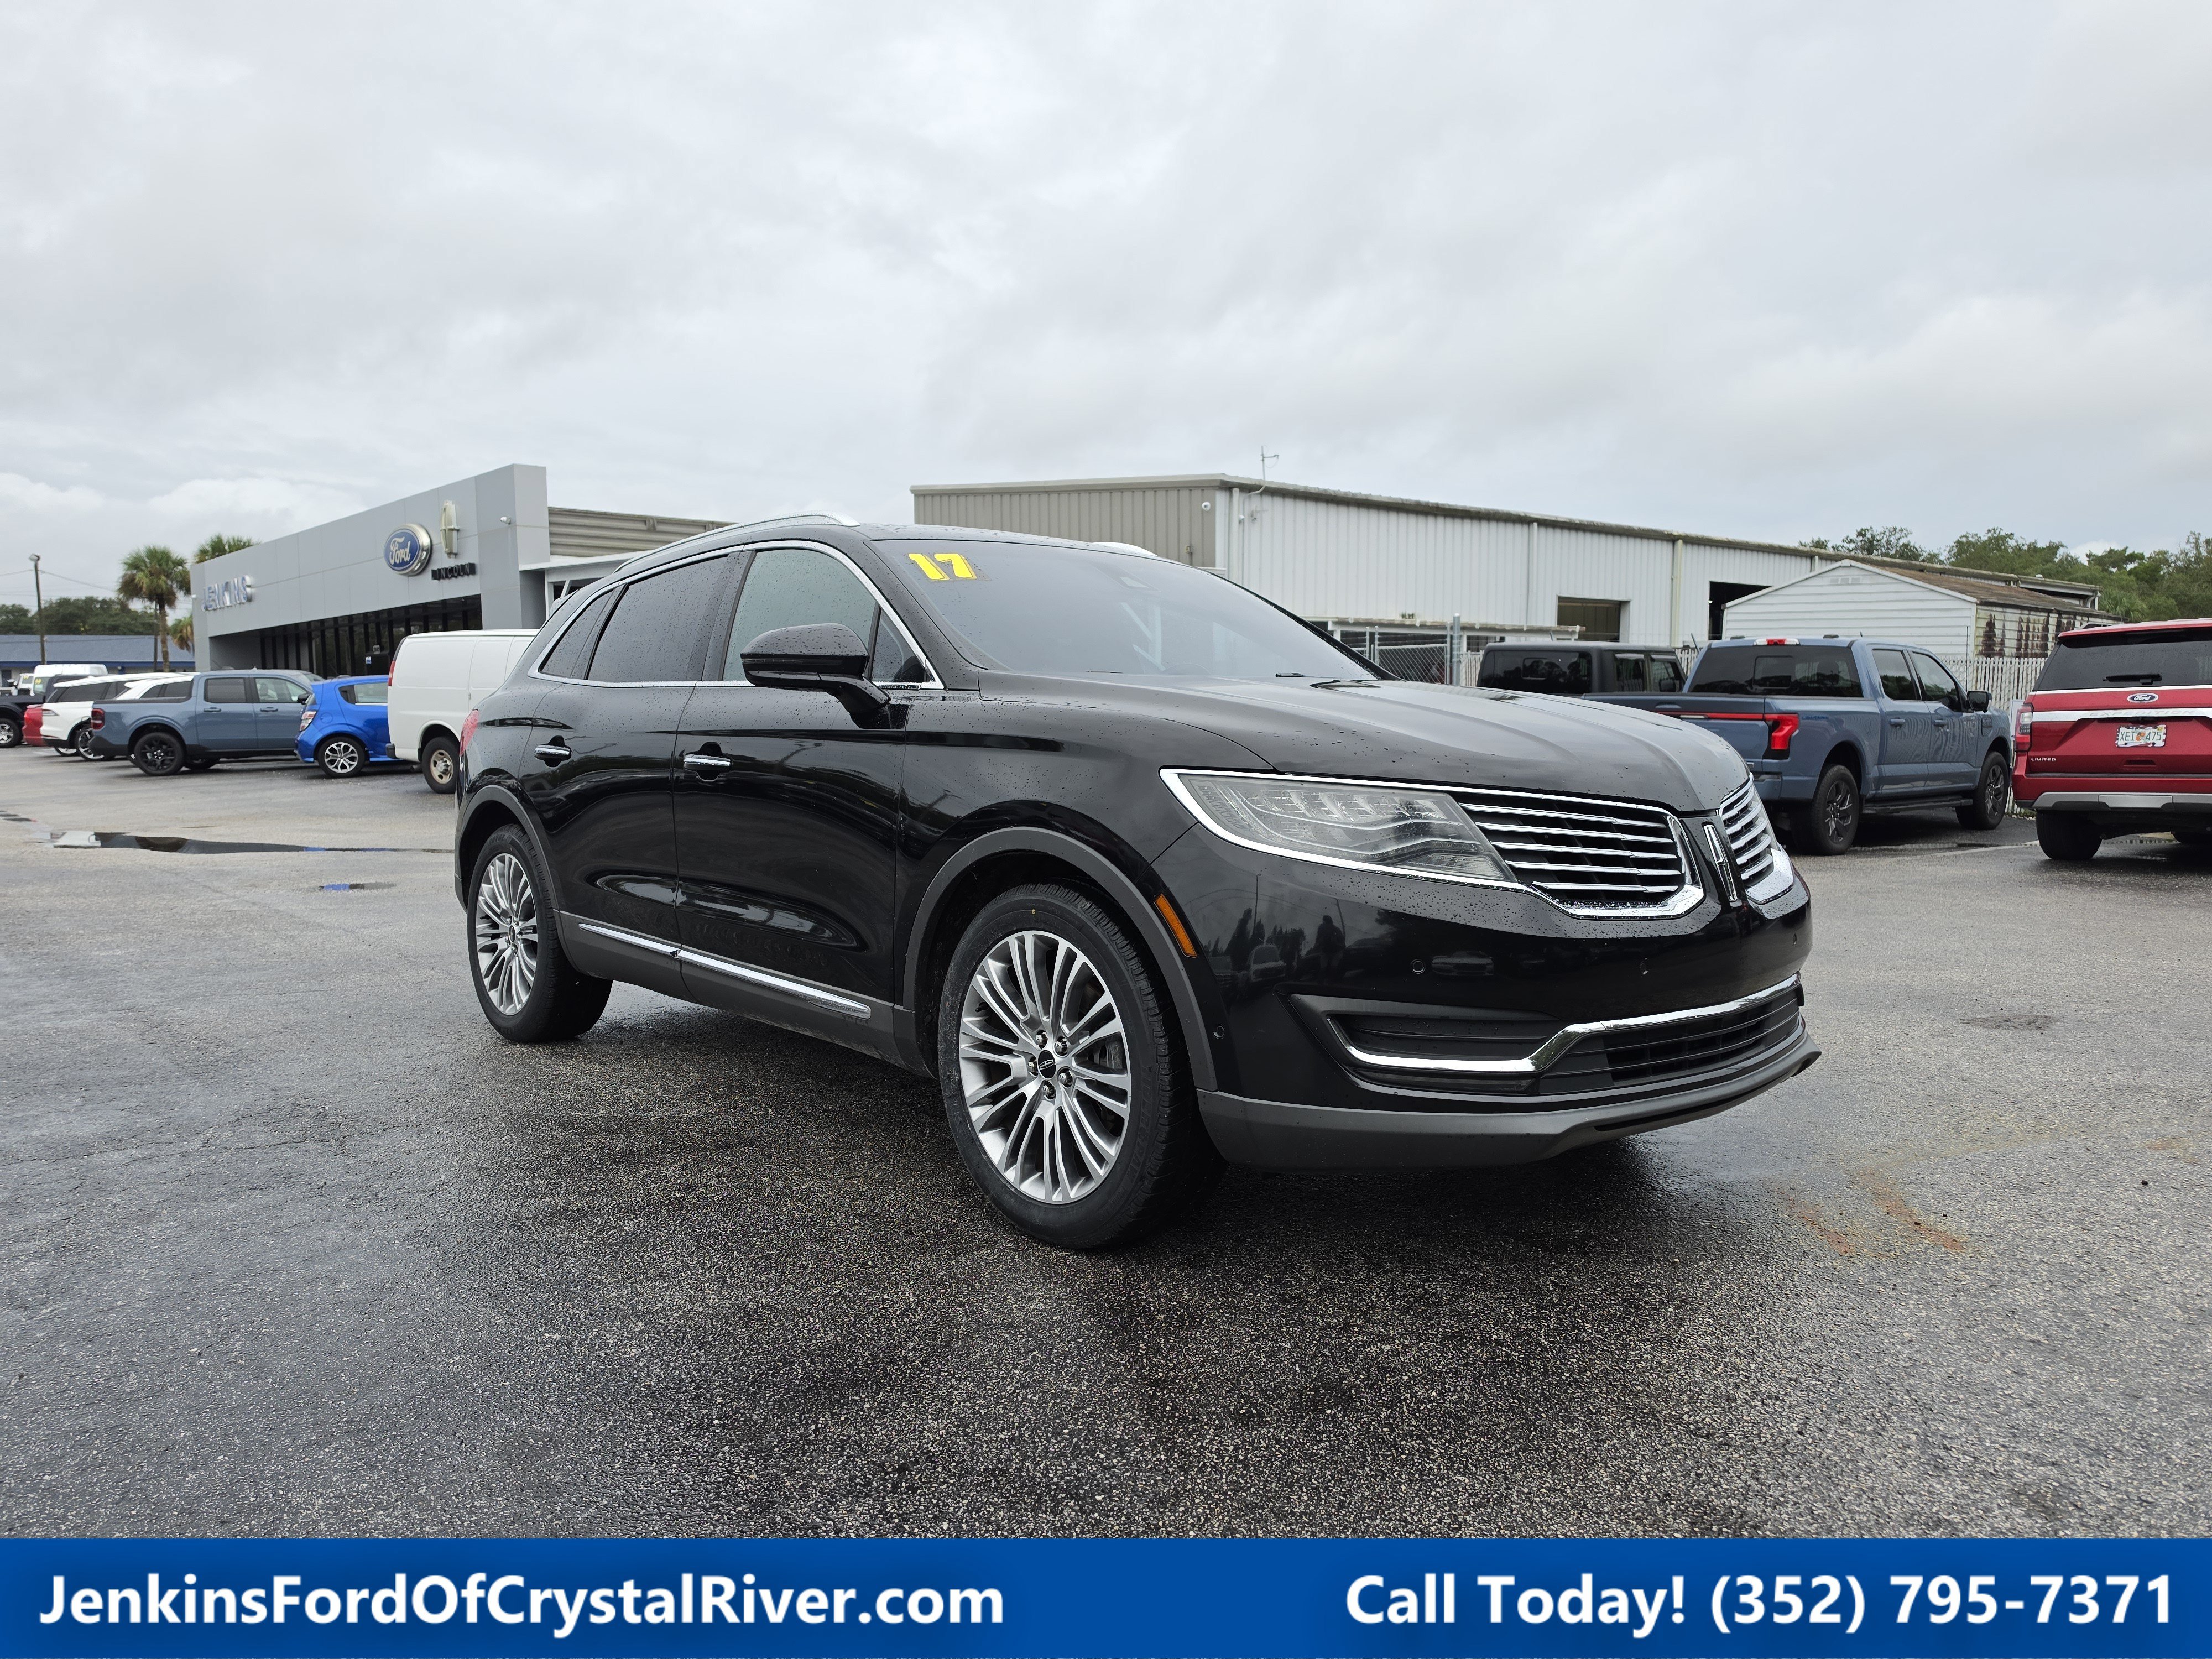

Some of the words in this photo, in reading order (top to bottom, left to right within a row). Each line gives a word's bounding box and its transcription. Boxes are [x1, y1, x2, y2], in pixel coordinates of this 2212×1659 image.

[389, 536, 411, 565] Ford
[909, 553, 977, 580] 17
[2145, 731, 2162, 742] 475
